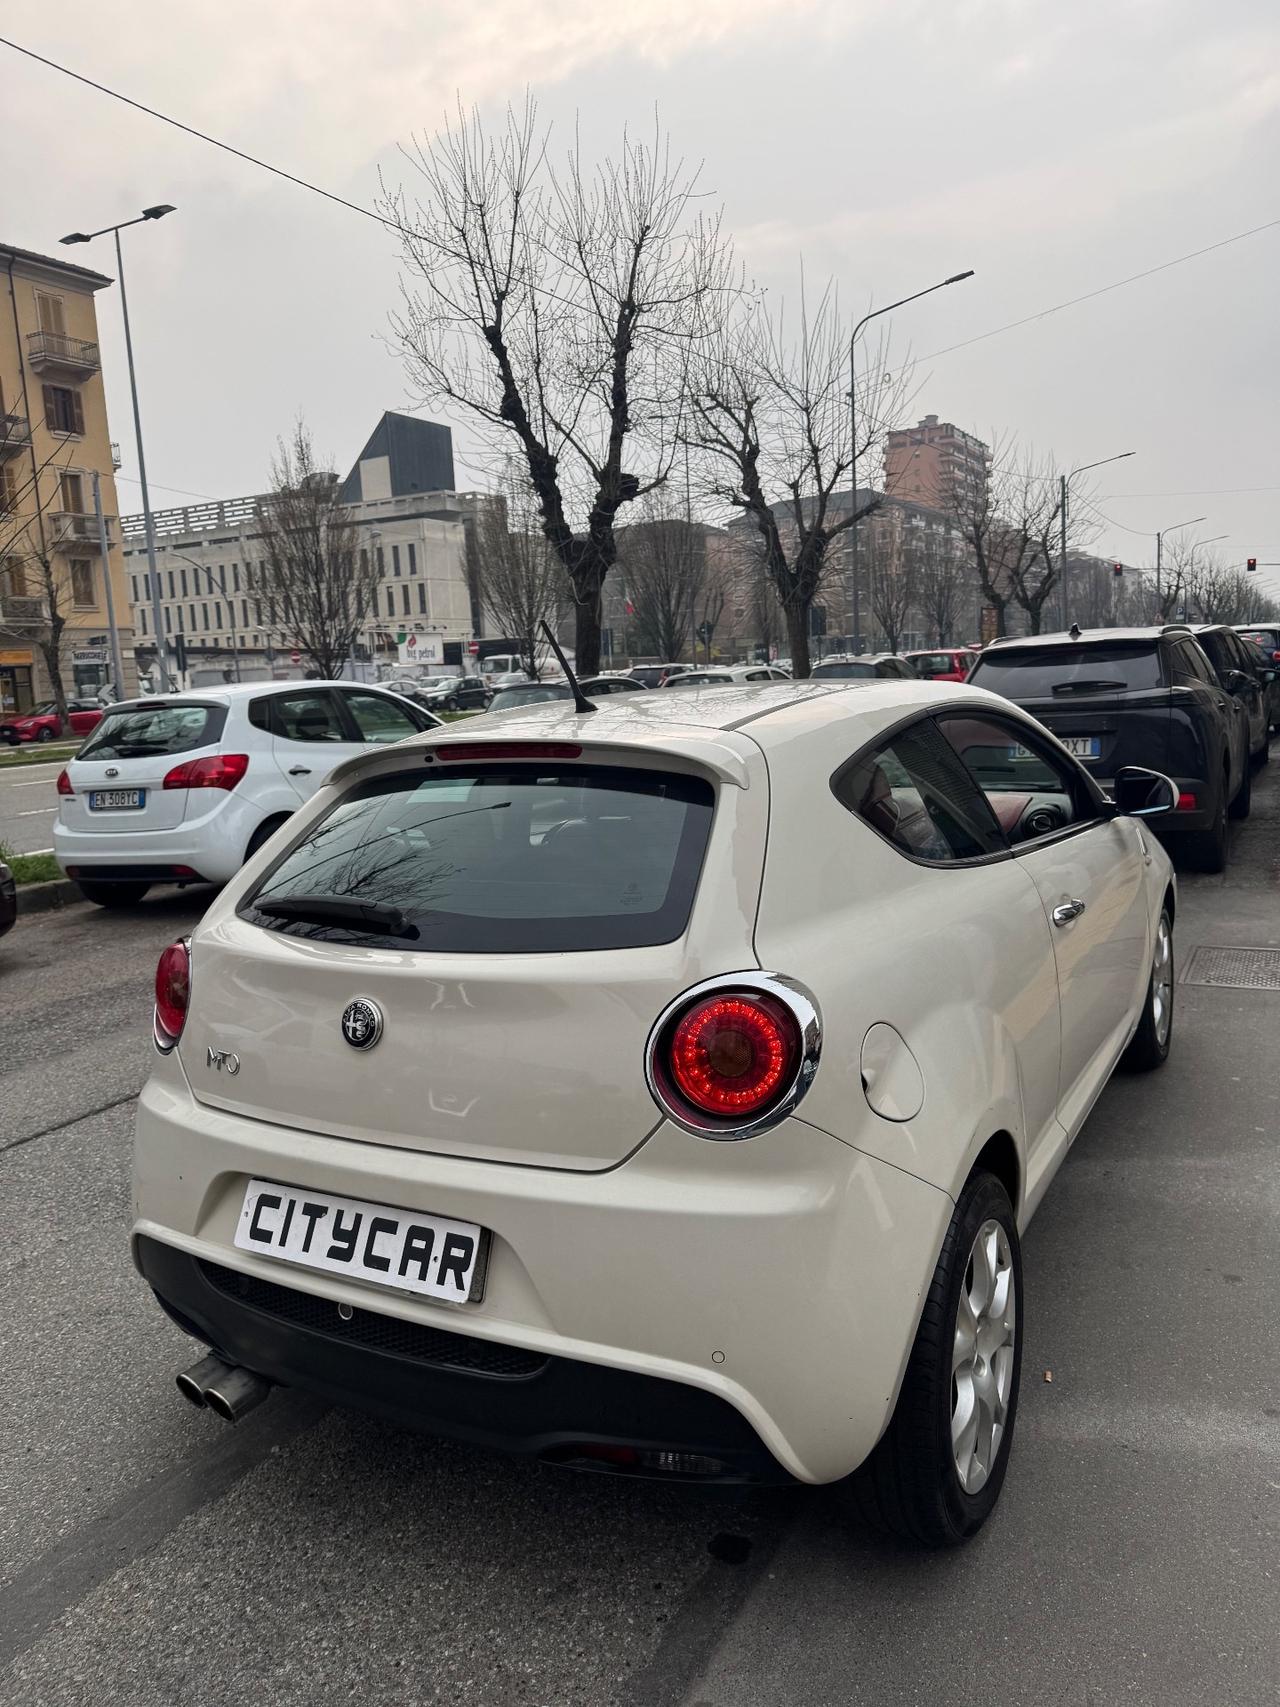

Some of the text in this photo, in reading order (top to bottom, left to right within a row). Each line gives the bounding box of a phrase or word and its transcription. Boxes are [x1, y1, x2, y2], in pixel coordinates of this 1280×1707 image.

[418, 645, 436, 660] petrol
[95, 791, 138, 806] EN 308YC
[249, 1193, 475, 1291] CITYCAR
